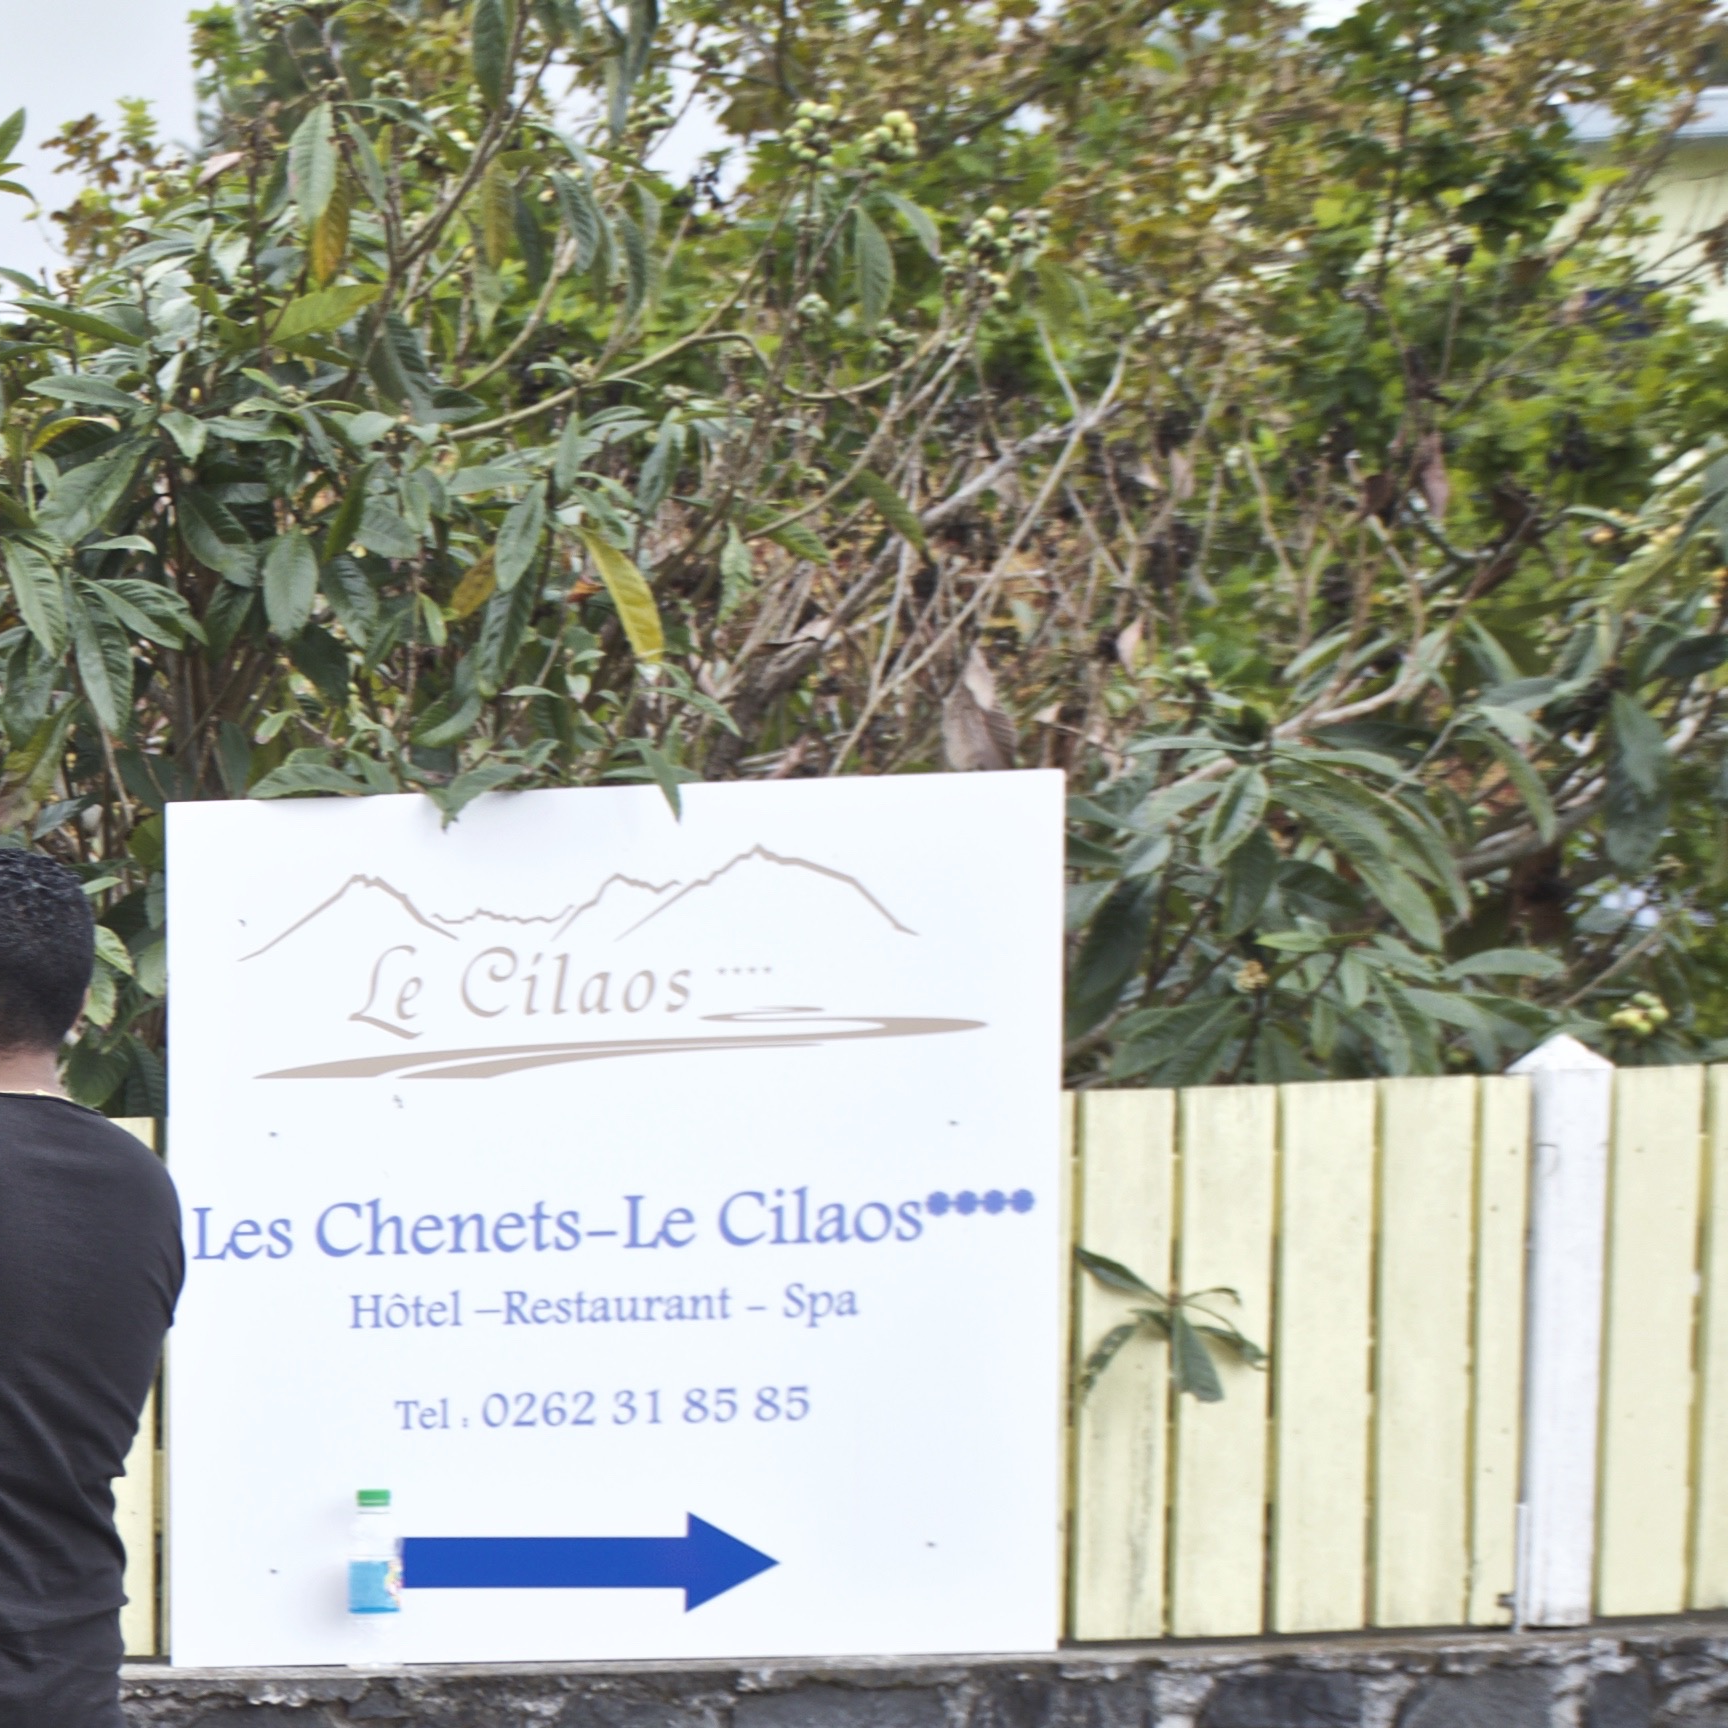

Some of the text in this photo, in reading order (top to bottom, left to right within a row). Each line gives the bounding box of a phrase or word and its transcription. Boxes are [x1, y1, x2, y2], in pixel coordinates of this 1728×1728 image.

[348, 944, 692, 1040] Le Cilaos
[191, 1206, 294, 1261] Les
[717, 1186, 924, 1247] Cilaos
[348, 1289, 463, 1330] Hôtel
[783, 1282, 860, 1329] Spa
[481, 1390, 596, 1429] 0262
[612, 1389, 663, 1426] 31
[682, 1387, 738, 1424] 85
[753, 1385, 811, 1422] 85
